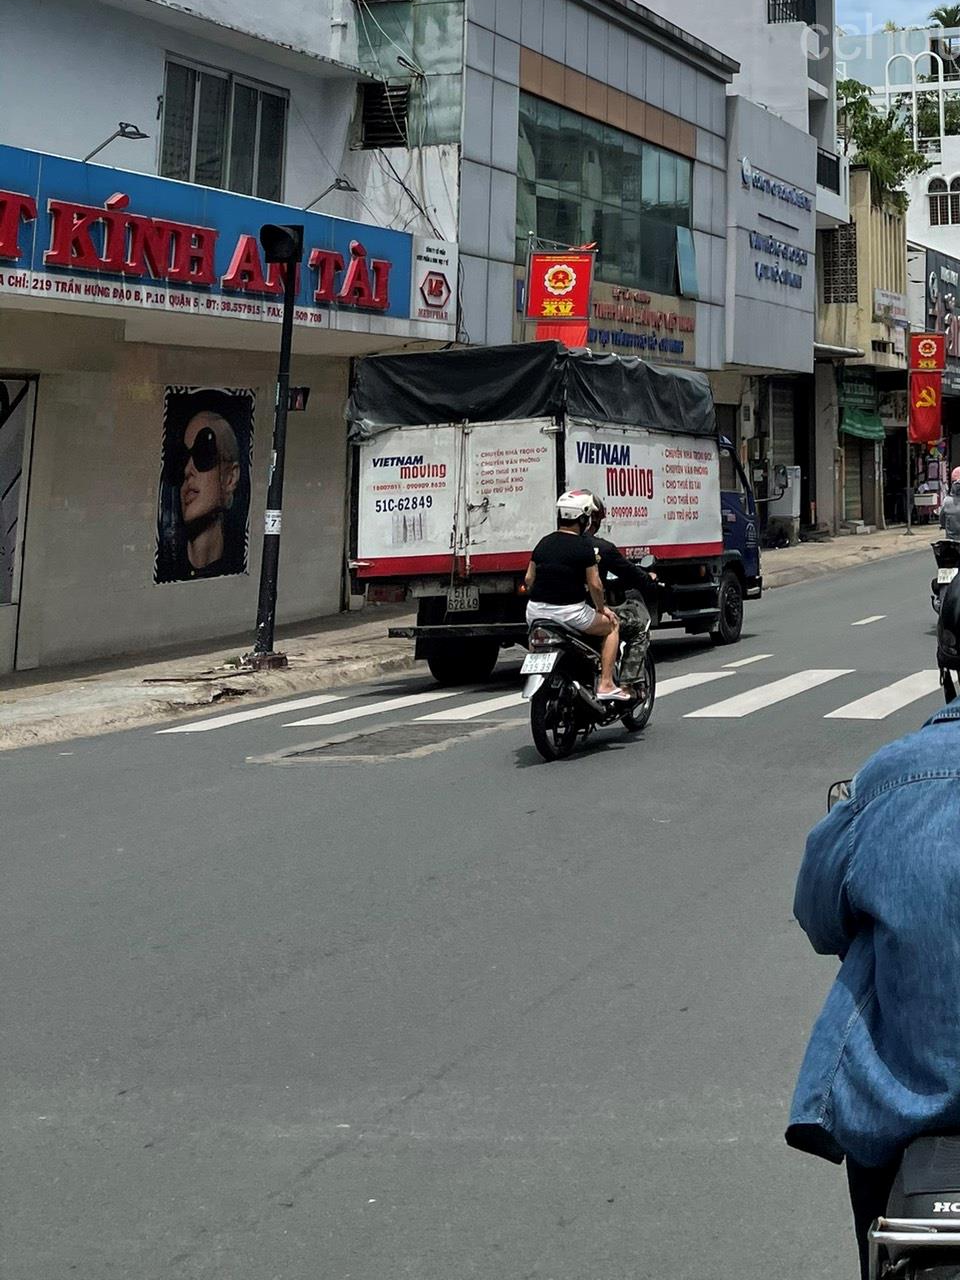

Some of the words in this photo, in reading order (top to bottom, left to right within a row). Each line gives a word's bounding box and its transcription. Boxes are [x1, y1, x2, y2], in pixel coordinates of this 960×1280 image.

[43, 192, 219, 287] KÍNH
[308, 240, 393, 310] TÀI
[8, 273, 29, 288] CHỈ:
[32, 279, 52, 291] 219
[112, 289, 132, 302] ĐẠO
[134, 291, 144, 304] B,
[146, 292, 166, 304] P.10
[169, 294, 191, 309] QUẬN
[193, 296, 199, 307] 5
[206, 300, 219, 311] ĐT:
[267, 307, 283, 318] FAX:
[372, 455, 423, 468] VIETNAM
[576, 441, 630, 466] VIETNAM
[400, 463, 447, 479] moving
[606, 464, 654, 499] moving
[375, 495, 433, 513] 51C-62849
